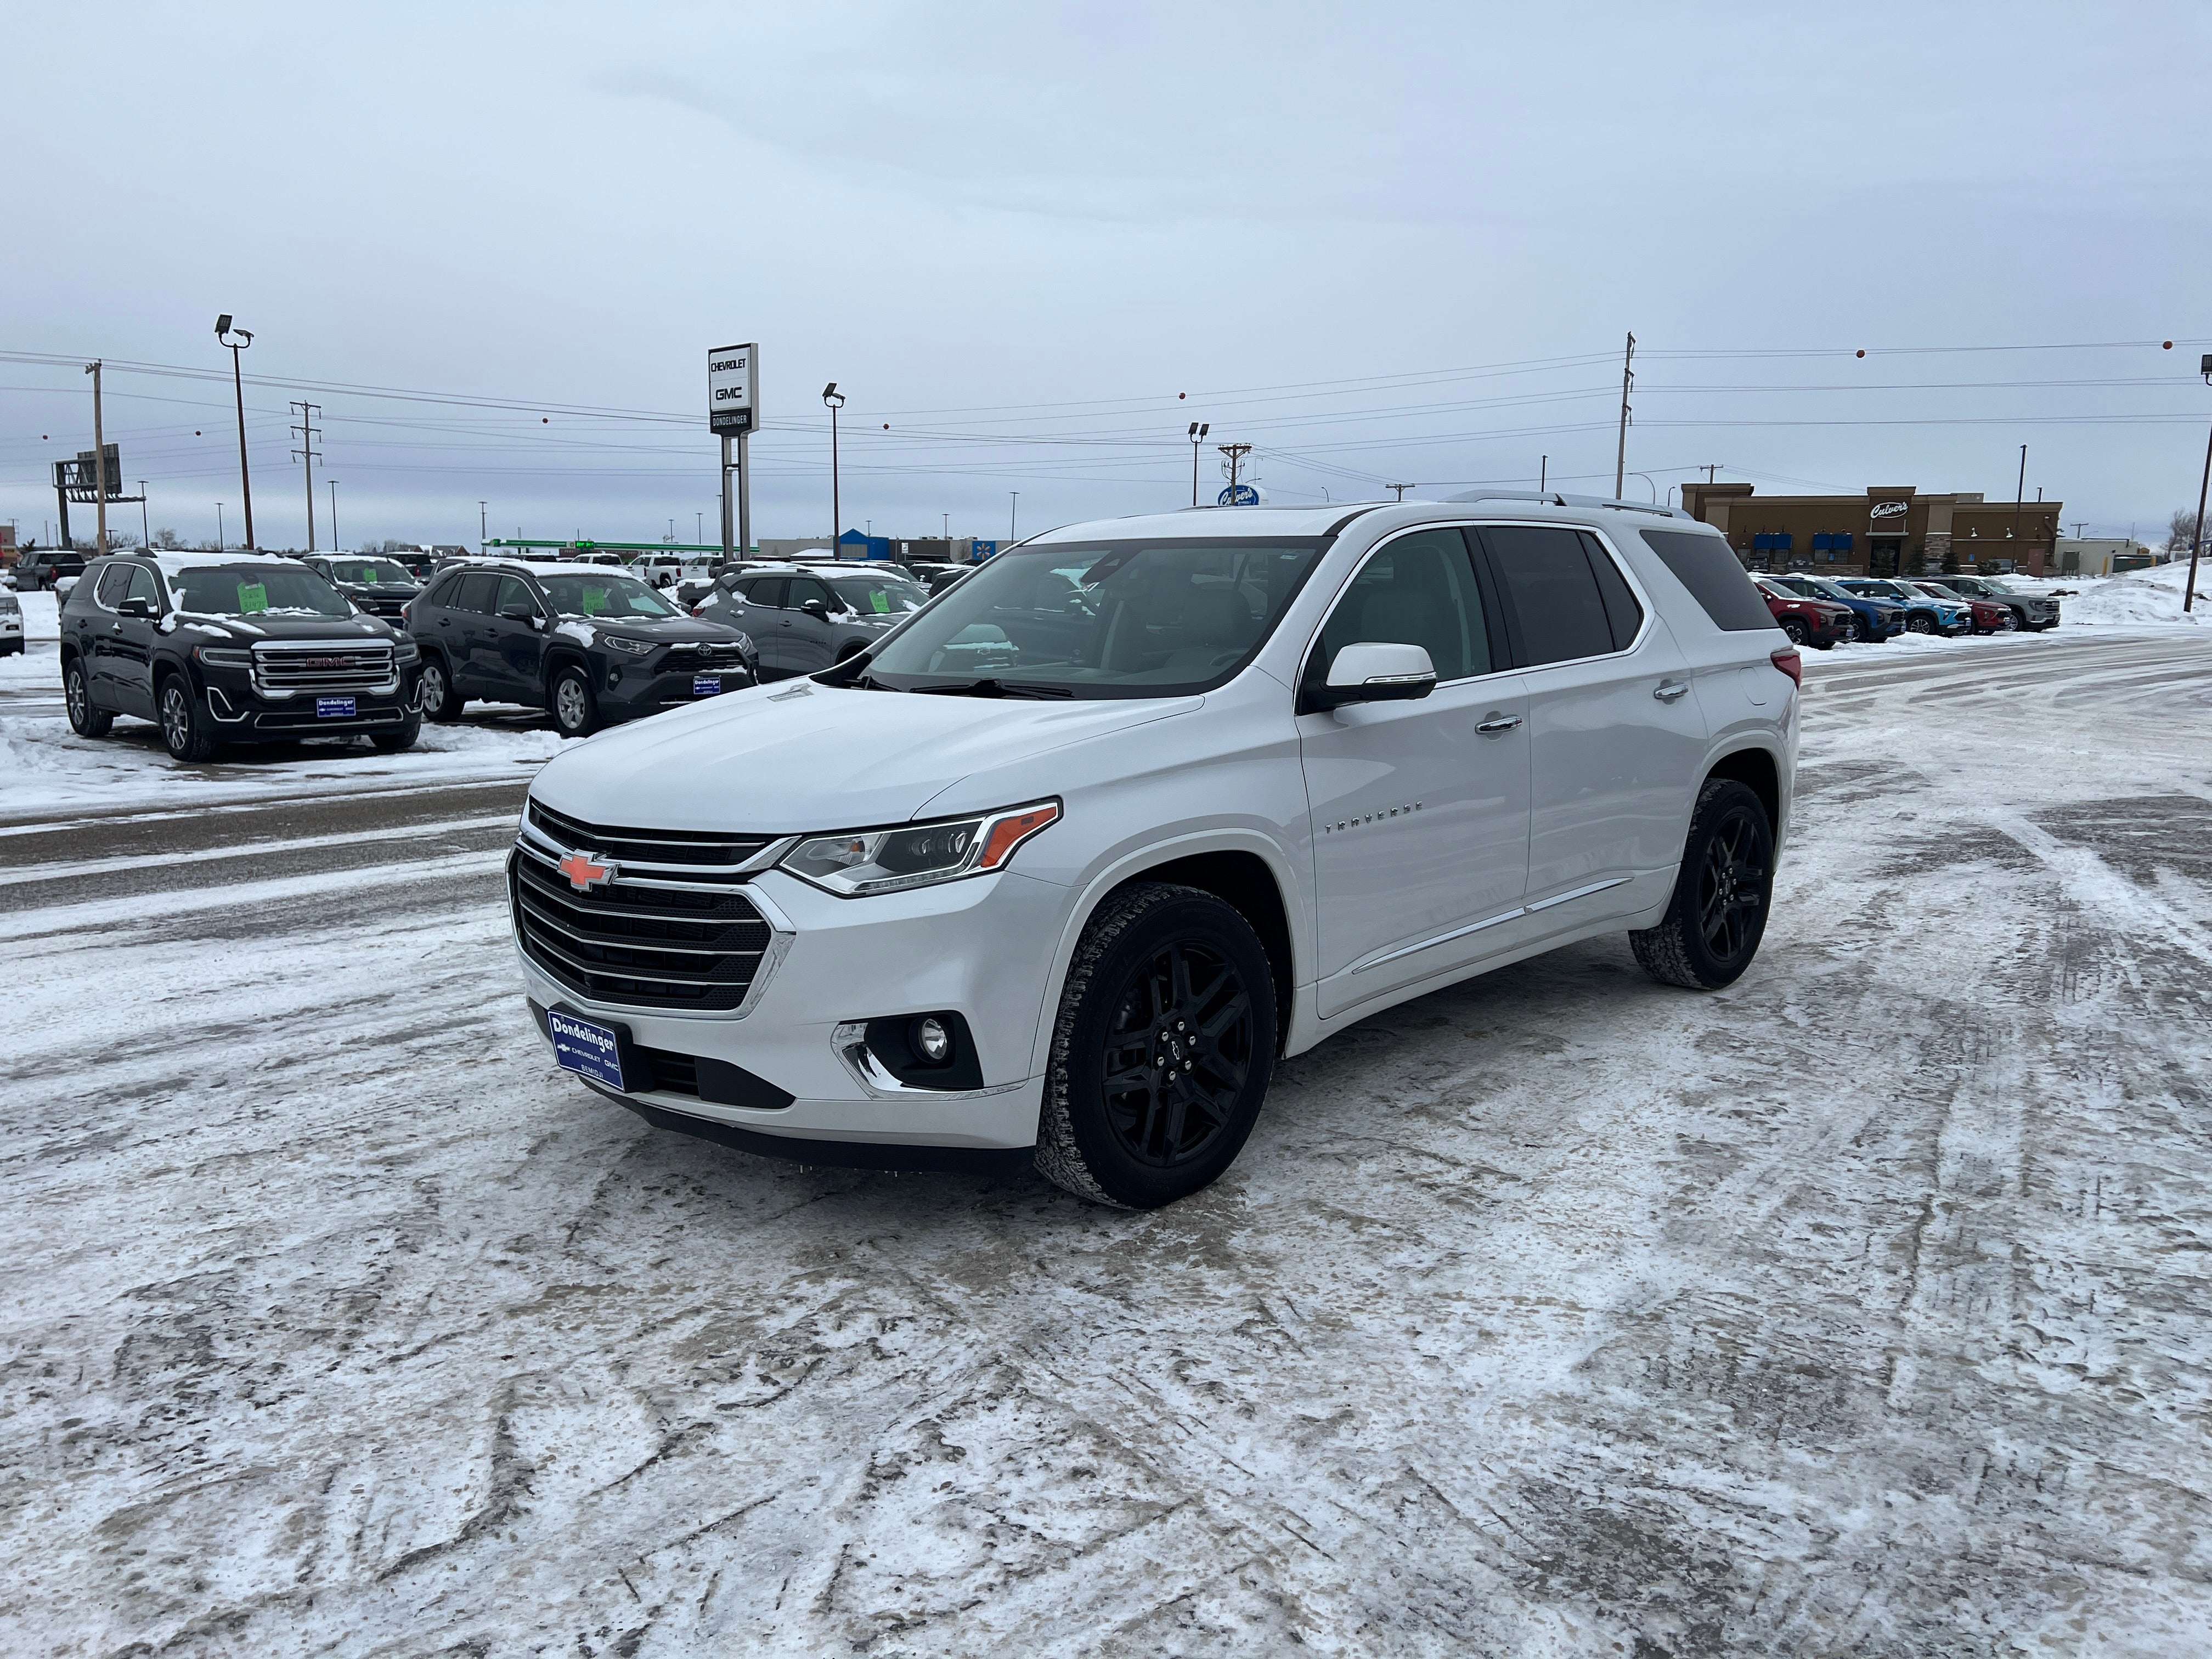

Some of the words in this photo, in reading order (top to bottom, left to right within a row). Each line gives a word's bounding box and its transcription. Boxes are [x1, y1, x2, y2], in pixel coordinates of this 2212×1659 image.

[711, 358, 746, 372] CHEVROLET
[715, 387, 742, 400] GMC
[713, 415, 747, 426] DONDELINGER
[1870, 501, 1908, 518] Culver's
[307, 656, 355, 667] GMC
[1325, 800, 1423, 834] TRAVERSE
[552, 1017, 614, 1053] Dondelinger
[572, 1047, 600, 1063] CHEVROLET
[604, 1059, 619, 1071] GMC
[581, 1064, 603, 1079] BEMIDJI
